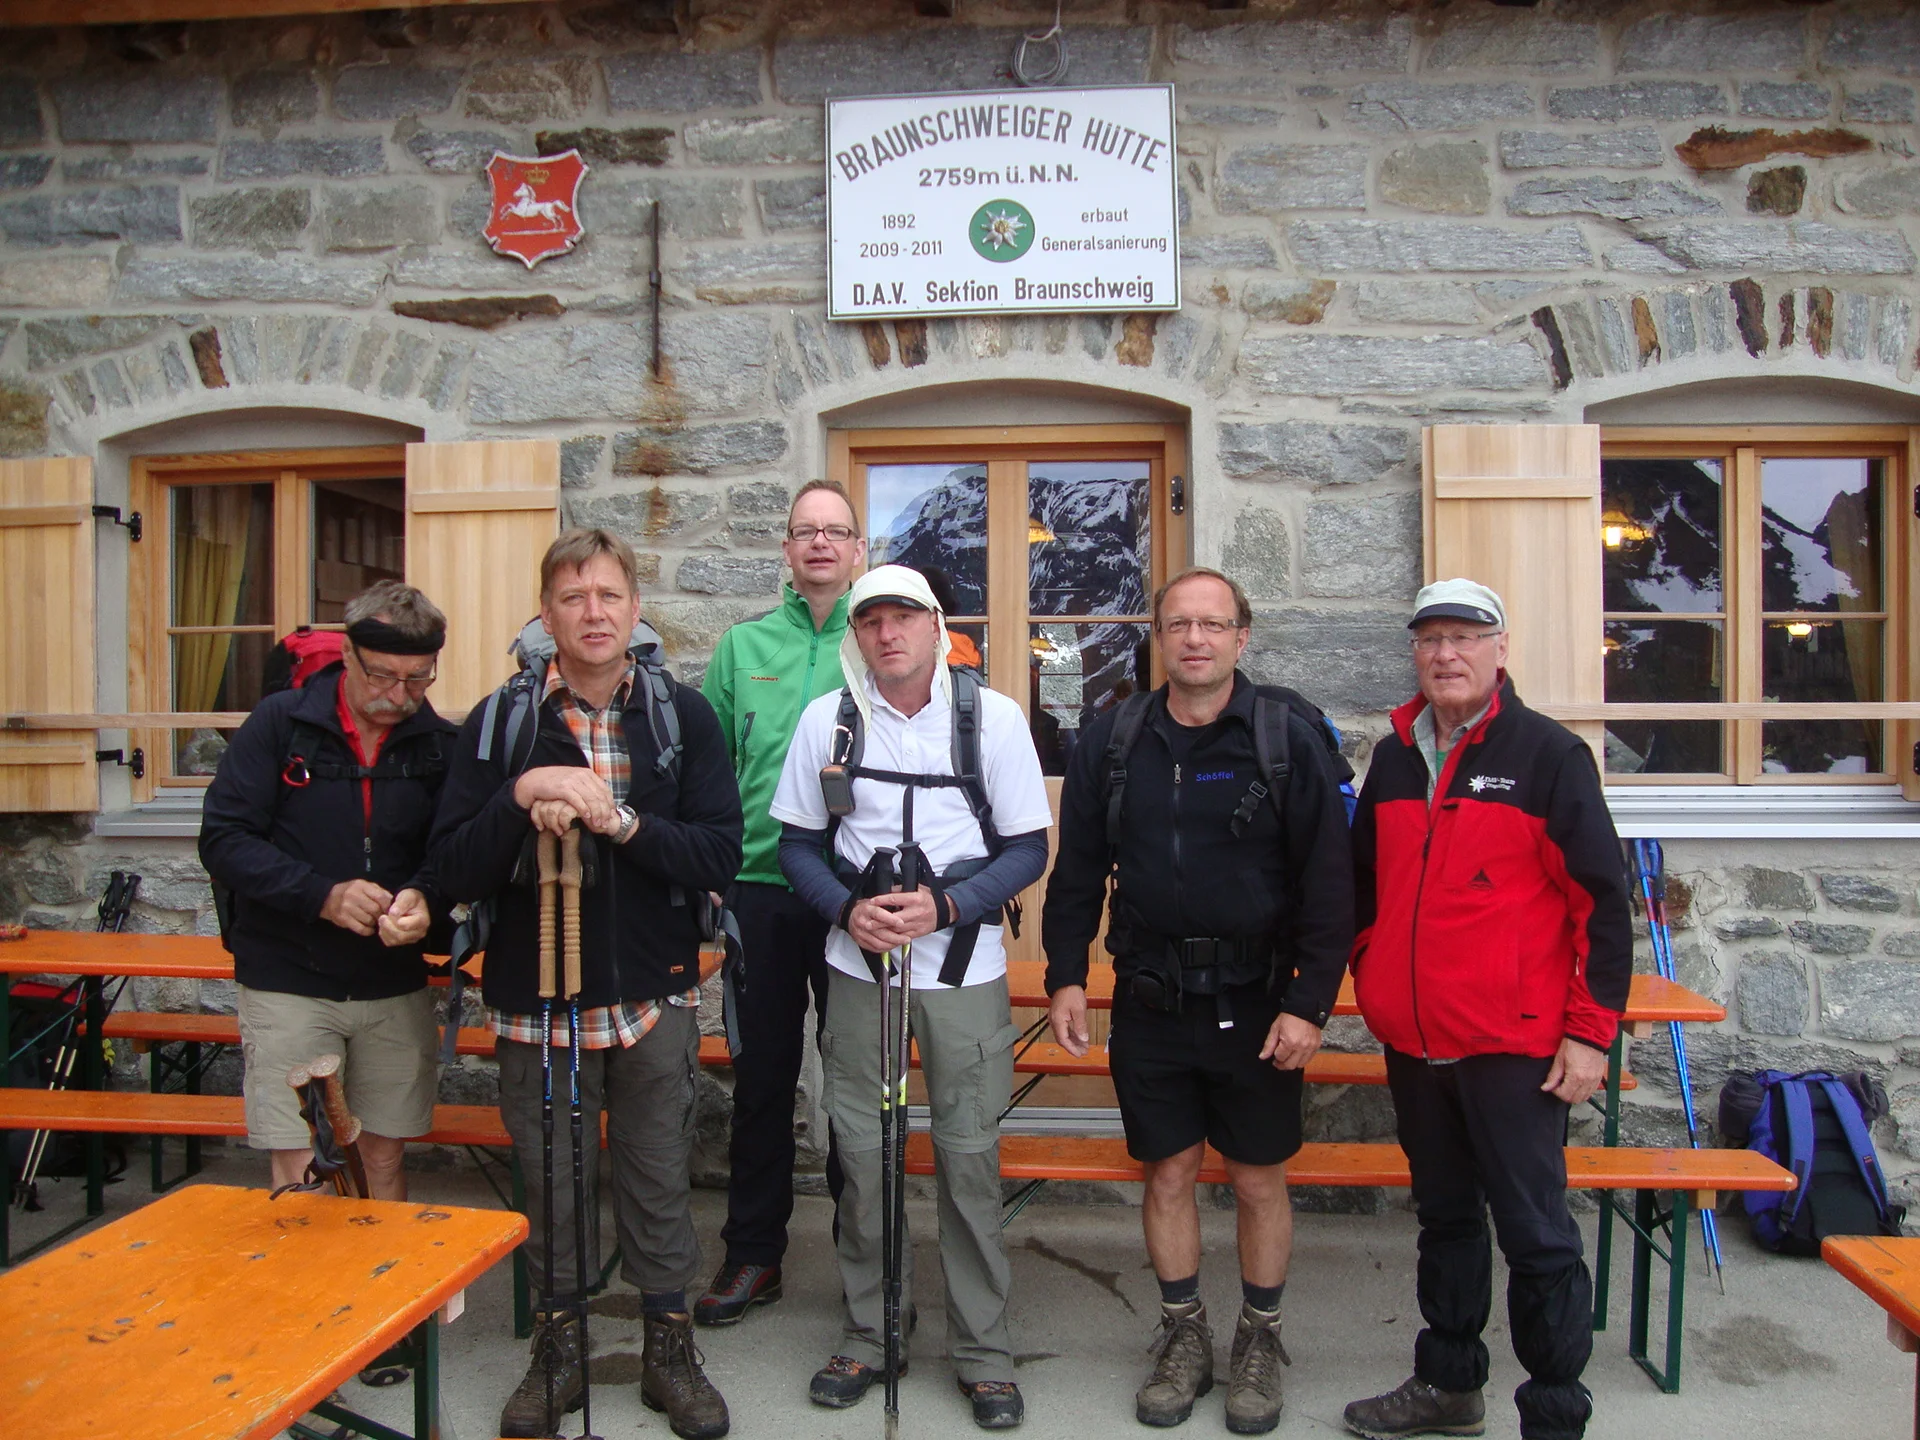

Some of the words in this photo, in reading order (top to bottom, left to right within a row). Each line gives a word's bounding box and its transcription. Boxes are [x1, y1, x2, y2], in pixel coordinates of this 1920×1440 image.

[835, 104, 1073, 182] BRAUNSCHWEIGER
[1082, 117, 1167, 173] HÜTTE
[918, 167, 1000, 187] 2759m
[882, 213, 916, 229] 1892
[1081, 208, 1129, 223] erbaut
[1041, 235, 1168, 253] Generalsanierung
[853, 282, 908, 307] D.A.V.
[925, 279, 999, 303] Sektion
[1014, 275, 1155, 303] Braunschweig
